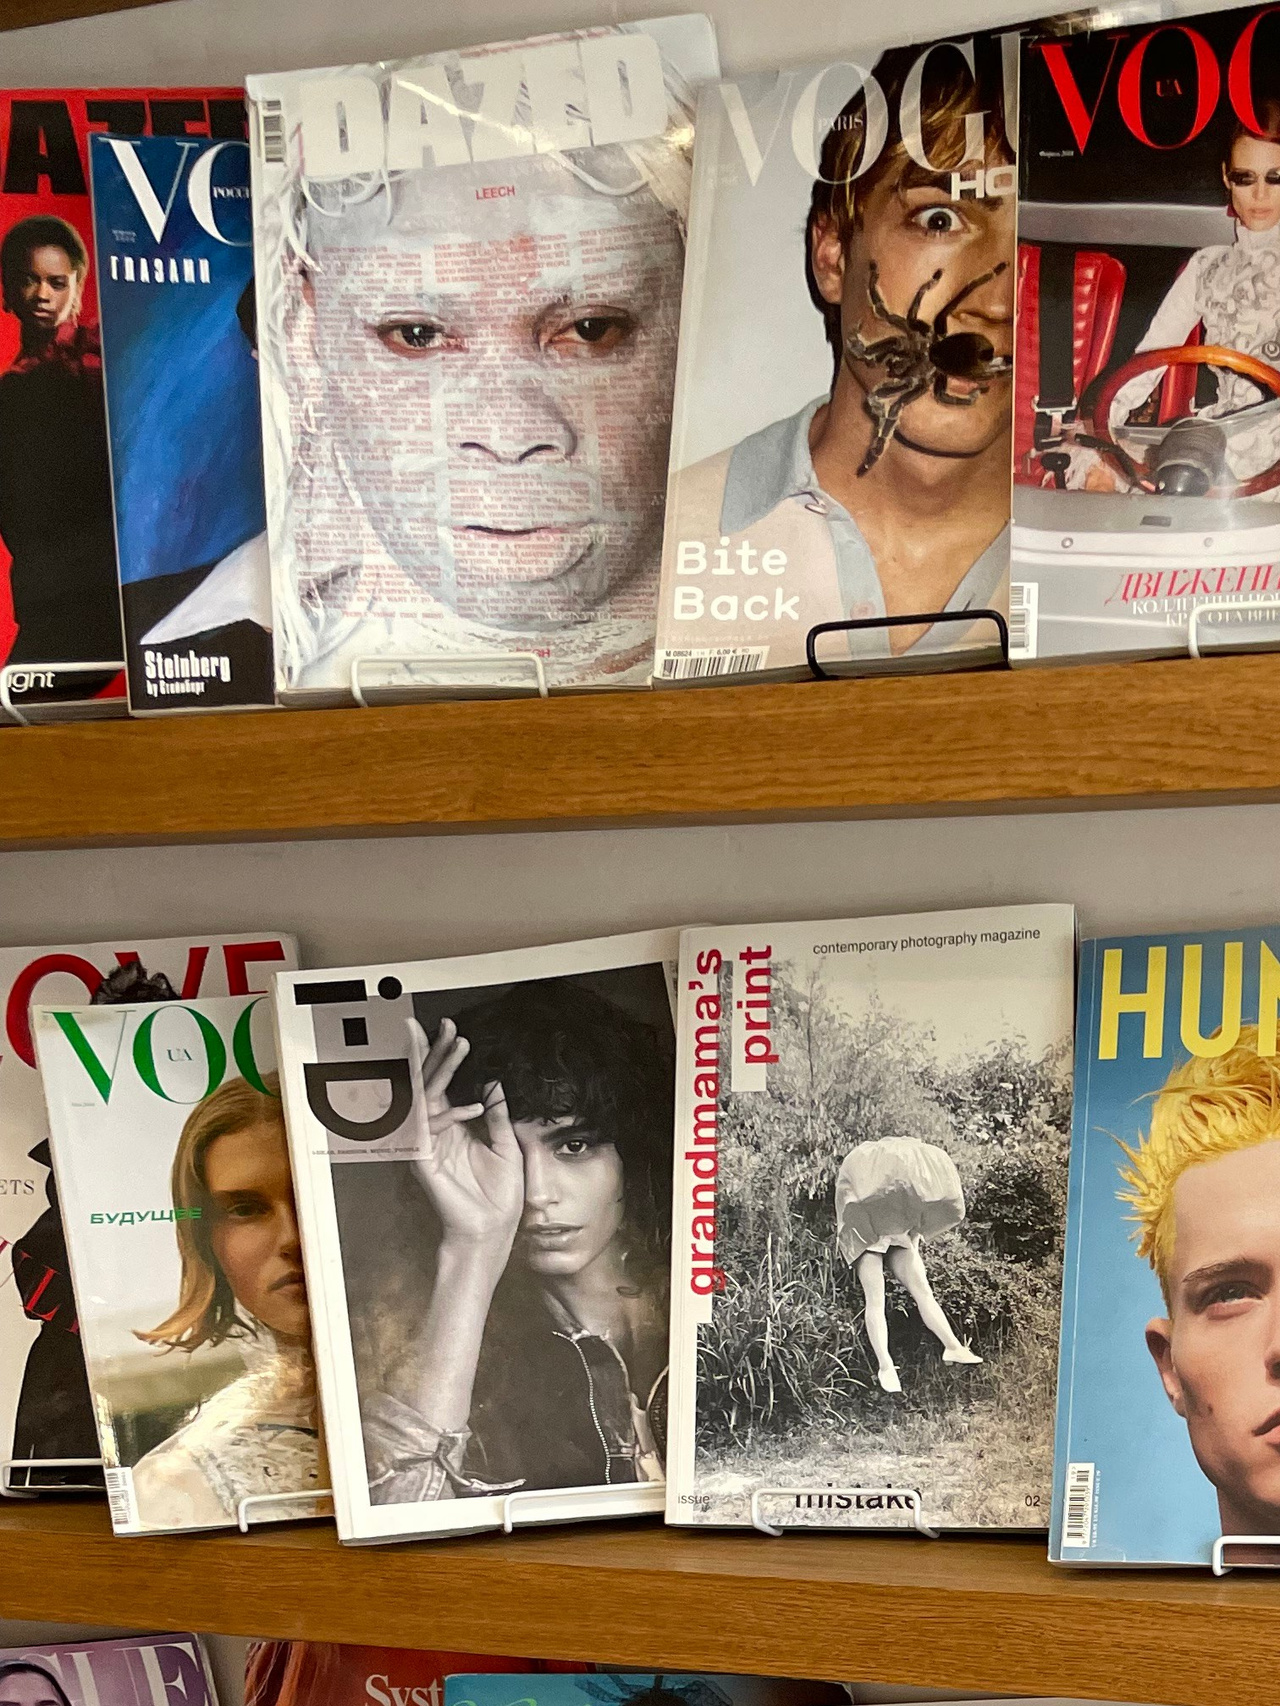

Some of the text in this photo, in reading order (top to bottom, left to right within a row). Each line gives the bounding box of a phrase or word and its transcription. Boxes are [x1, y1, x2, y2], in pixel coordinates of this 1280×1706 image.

[1156, 79, 1182, 97] UA
[299, 33, 668, 178] DAZED
[818, 113, 864, 132] PARIS
[476, 184, 517, 201] LEECH
[676, 537, 788, 576] Bite
[673, 585, 801, 622] Back
[144, 650, 232, 682] Steinberg
[812, 926, 1041, 955] contemporary photography magazine
[736, 943, 780, 1067] print
[167, 1047, 194, 1062] UA
[90, 1207, 203, 1227] БУДУЩЕЕ
[677, 1493, 711, 1506] issue
[795, 1482, 922, 1510] mistake
[1025, 1494, 1042, 1508] 02
